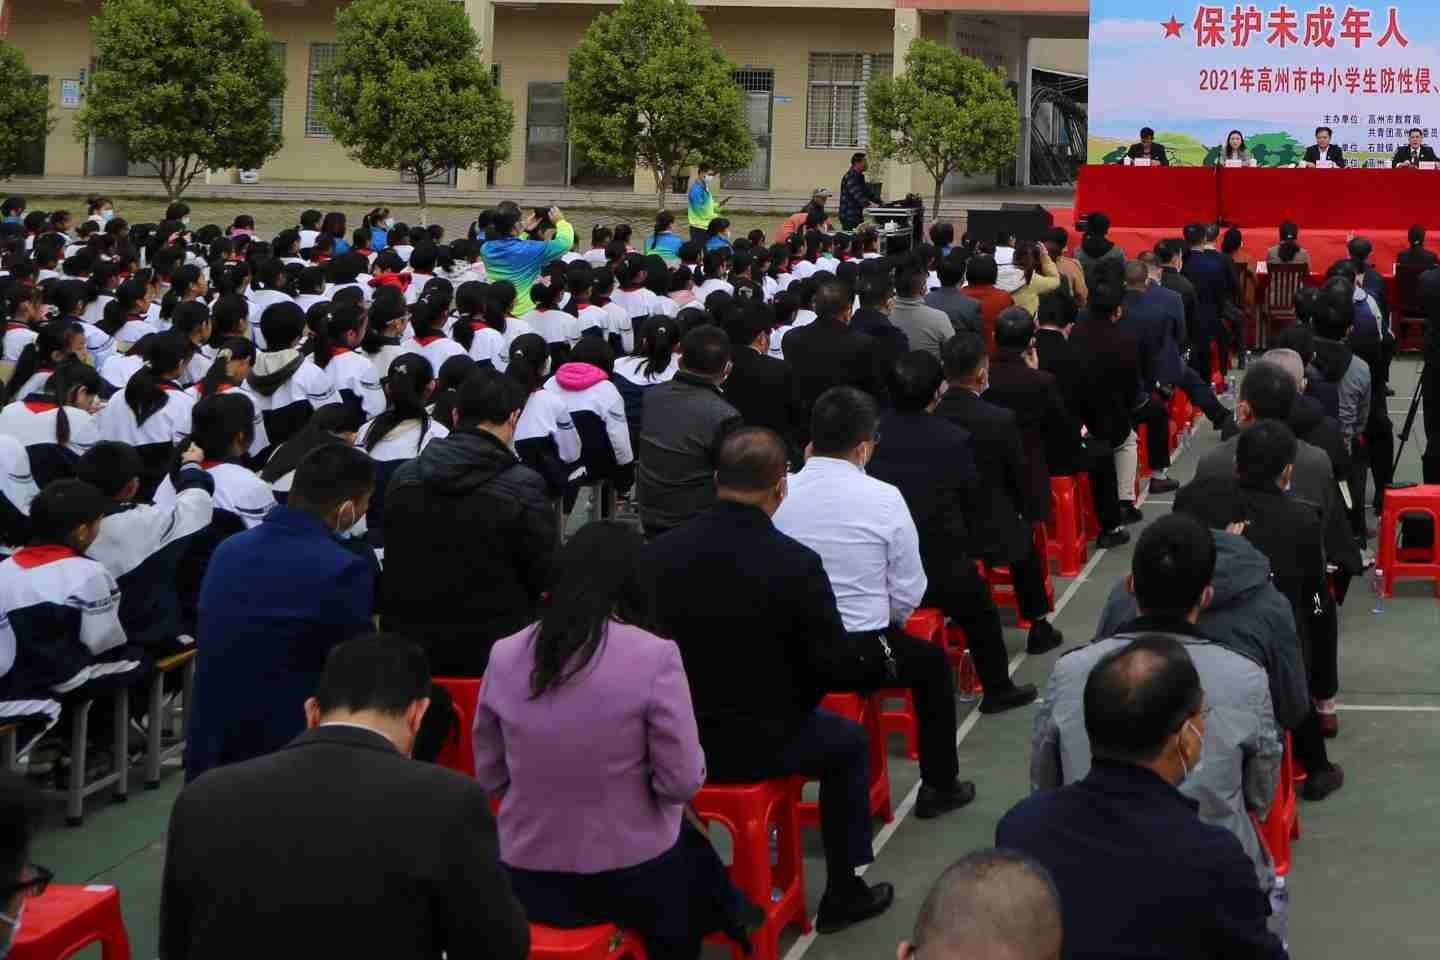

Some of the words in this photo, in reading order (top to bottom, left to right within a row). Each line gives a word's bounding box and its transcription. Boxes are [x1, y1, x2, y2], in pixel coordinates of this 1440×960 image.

[1193, 5, 1410, 50] 保护未成年人
